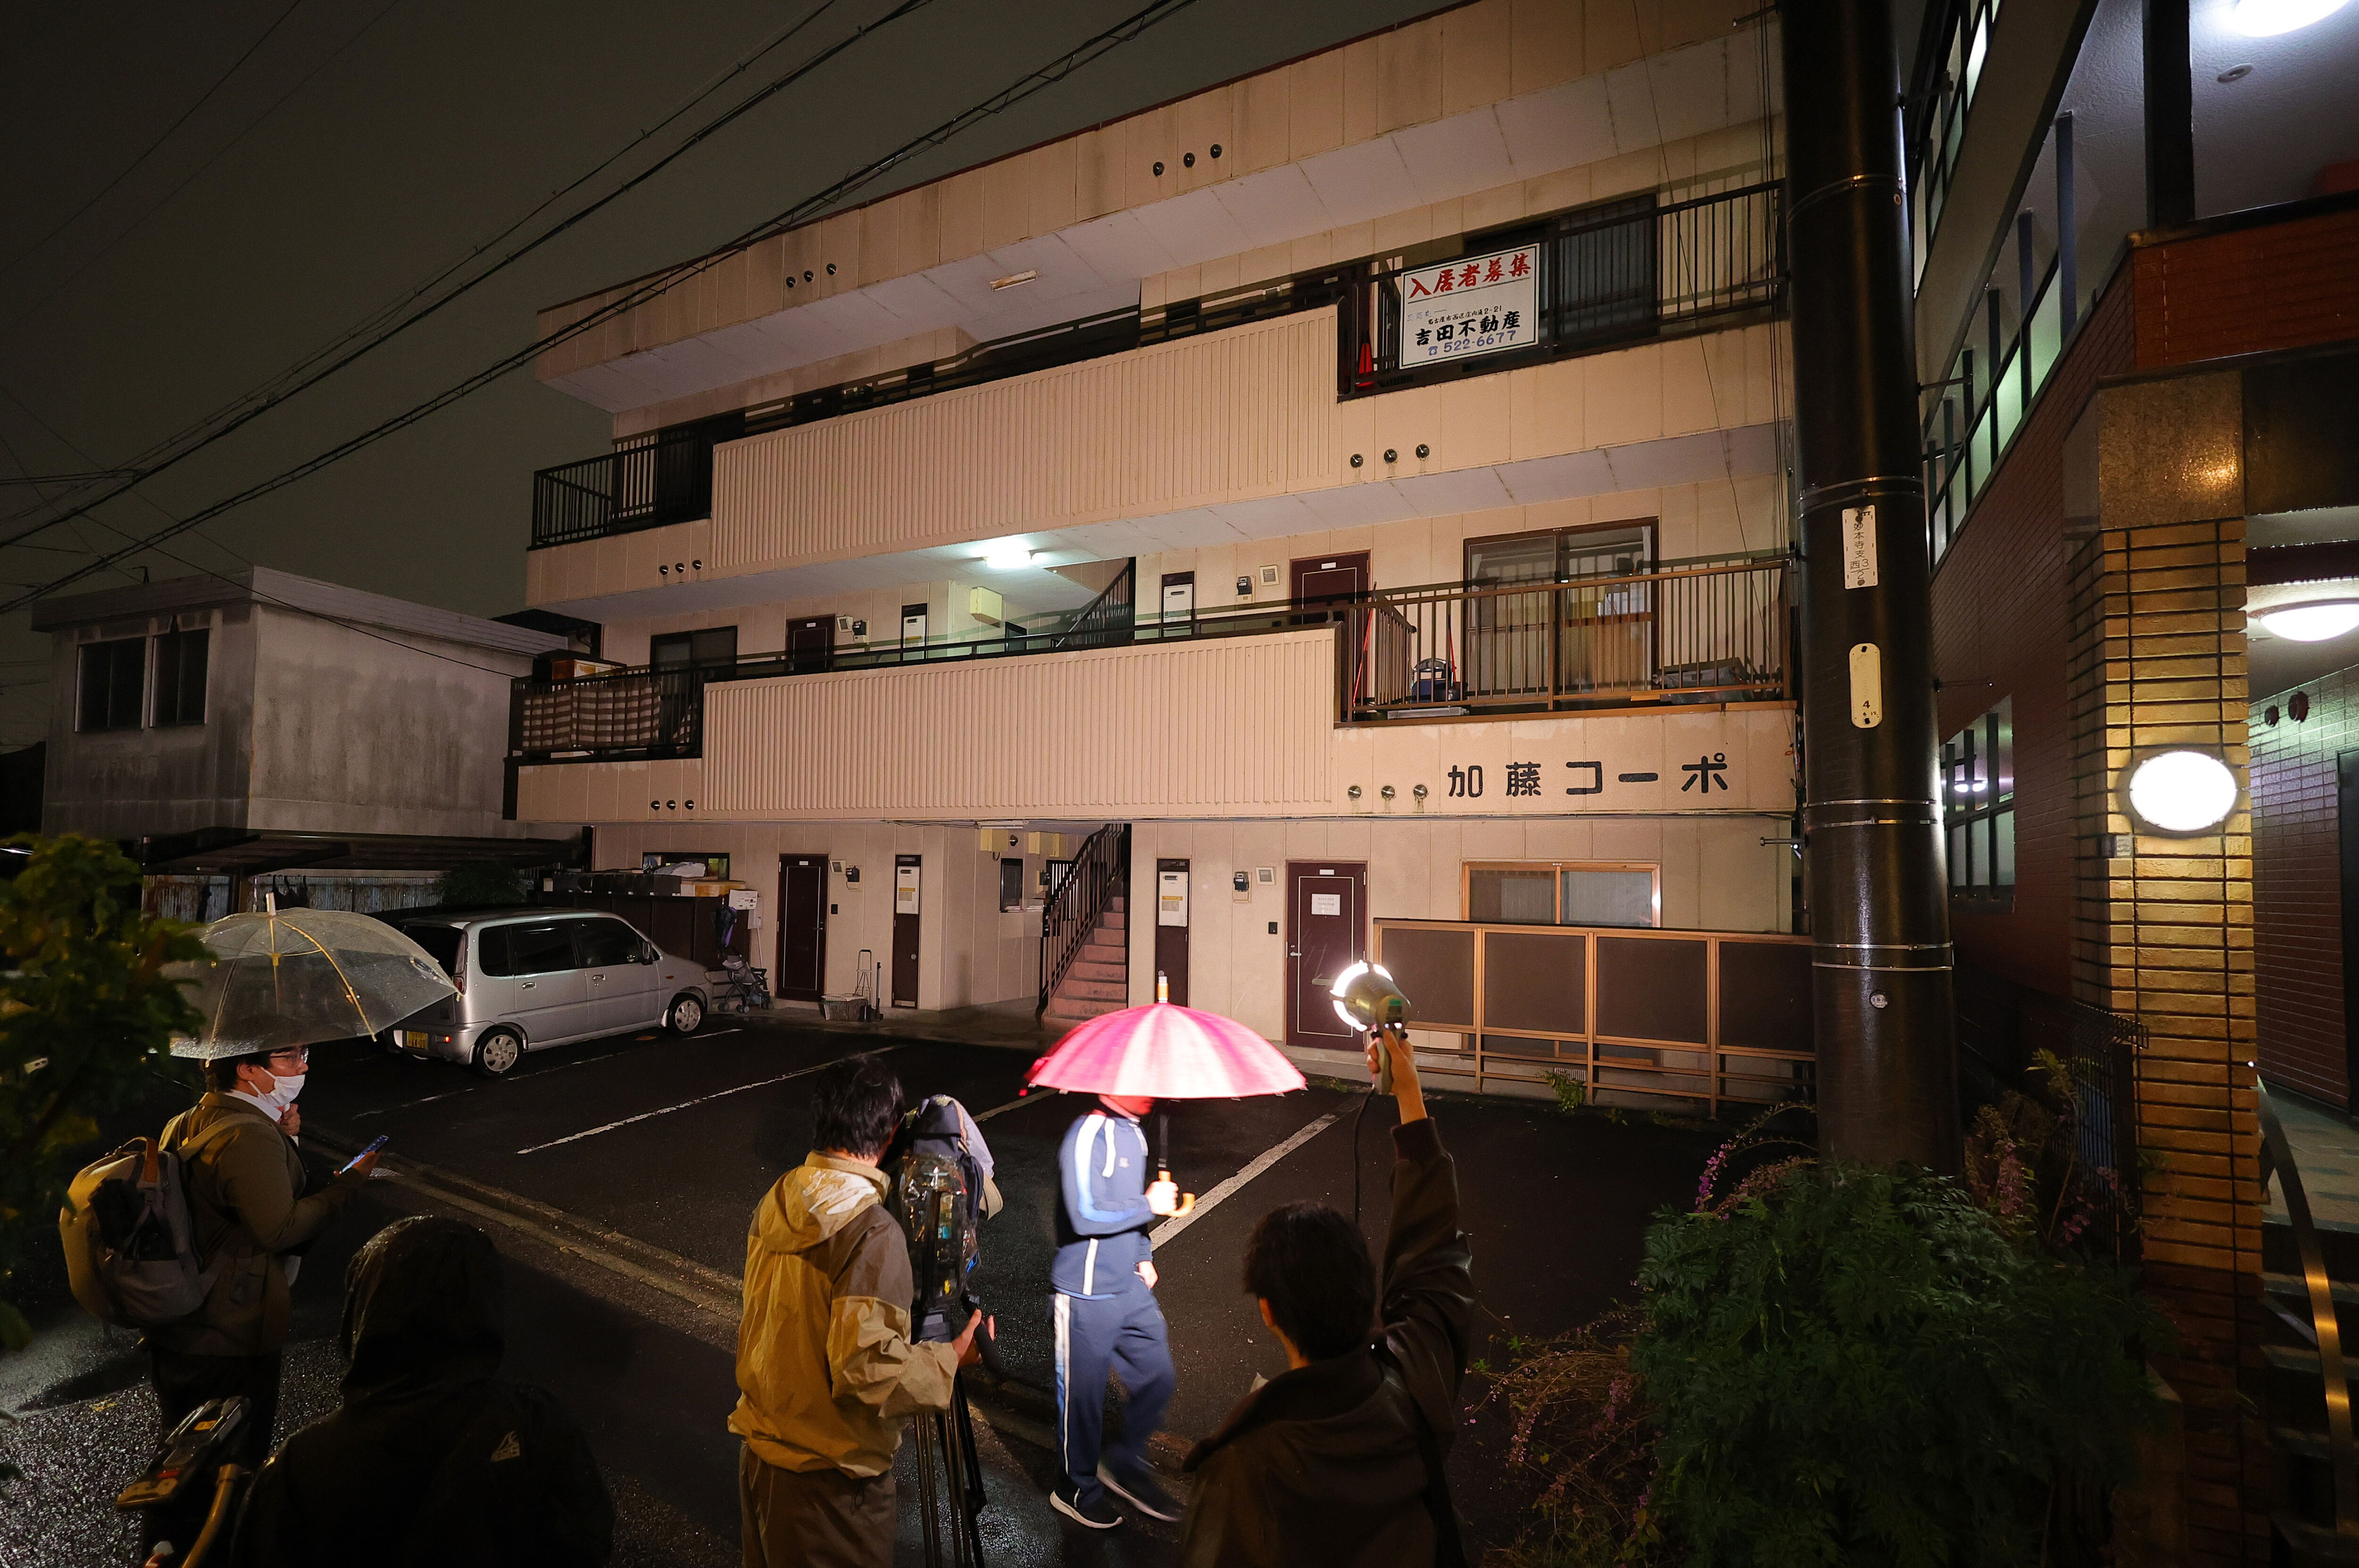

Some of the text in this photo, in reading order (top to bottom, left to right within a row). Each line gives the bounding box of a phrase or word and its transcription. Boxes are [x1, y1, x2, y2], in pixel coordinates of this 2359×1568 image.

[1408, 253, 1531, 299] 入居者募集
[1415, 311, 1521, 346] 吉田不動産
[1444, 330, 1516, 353] 522-6677
[1863, 700, 1870, 709] 4
[1447, 752, 1728, 798] 加藤コーポ
